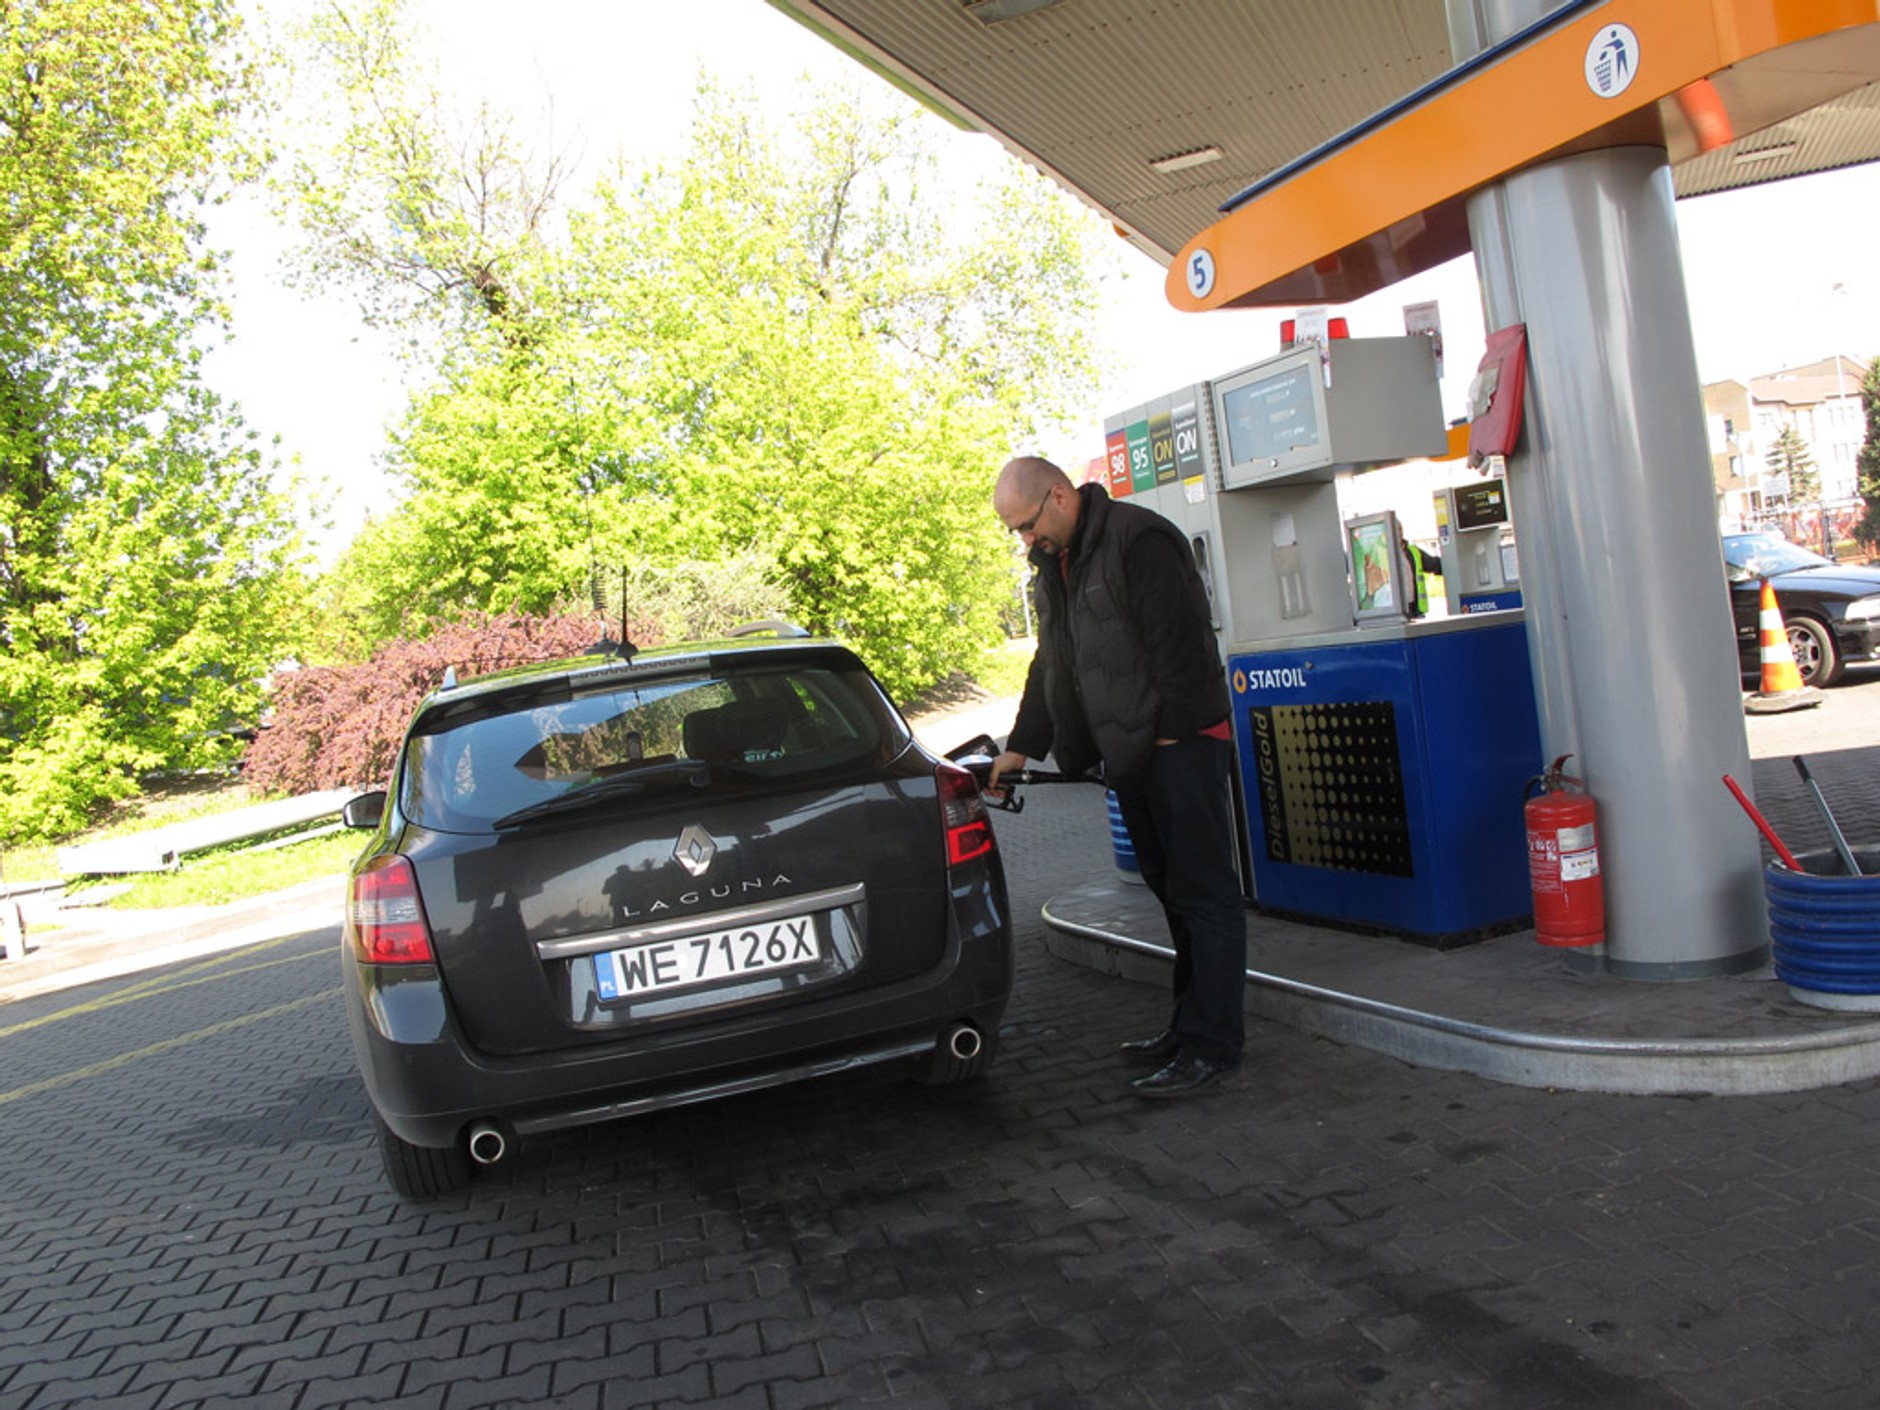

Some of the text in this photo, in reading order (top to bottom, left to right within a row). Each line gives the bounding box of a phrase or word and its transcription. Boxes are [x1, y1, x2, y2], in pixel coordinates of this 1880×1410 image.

[1193, 255, 1206, 290] 5
[1154, 438, 1173, 462] ON
[1176, 427, 1197, 454] ON
[1110, 452, 1126, 476] 98
[1132, 446, 1149, 470] 95
[1249, 668, 1307, 690] STATOIL
[1253, 711, 1286, 859] DieselGold
[622, 873, 793, 918] LAGUNA
[619, 919, 814, 991] WE 7126X
